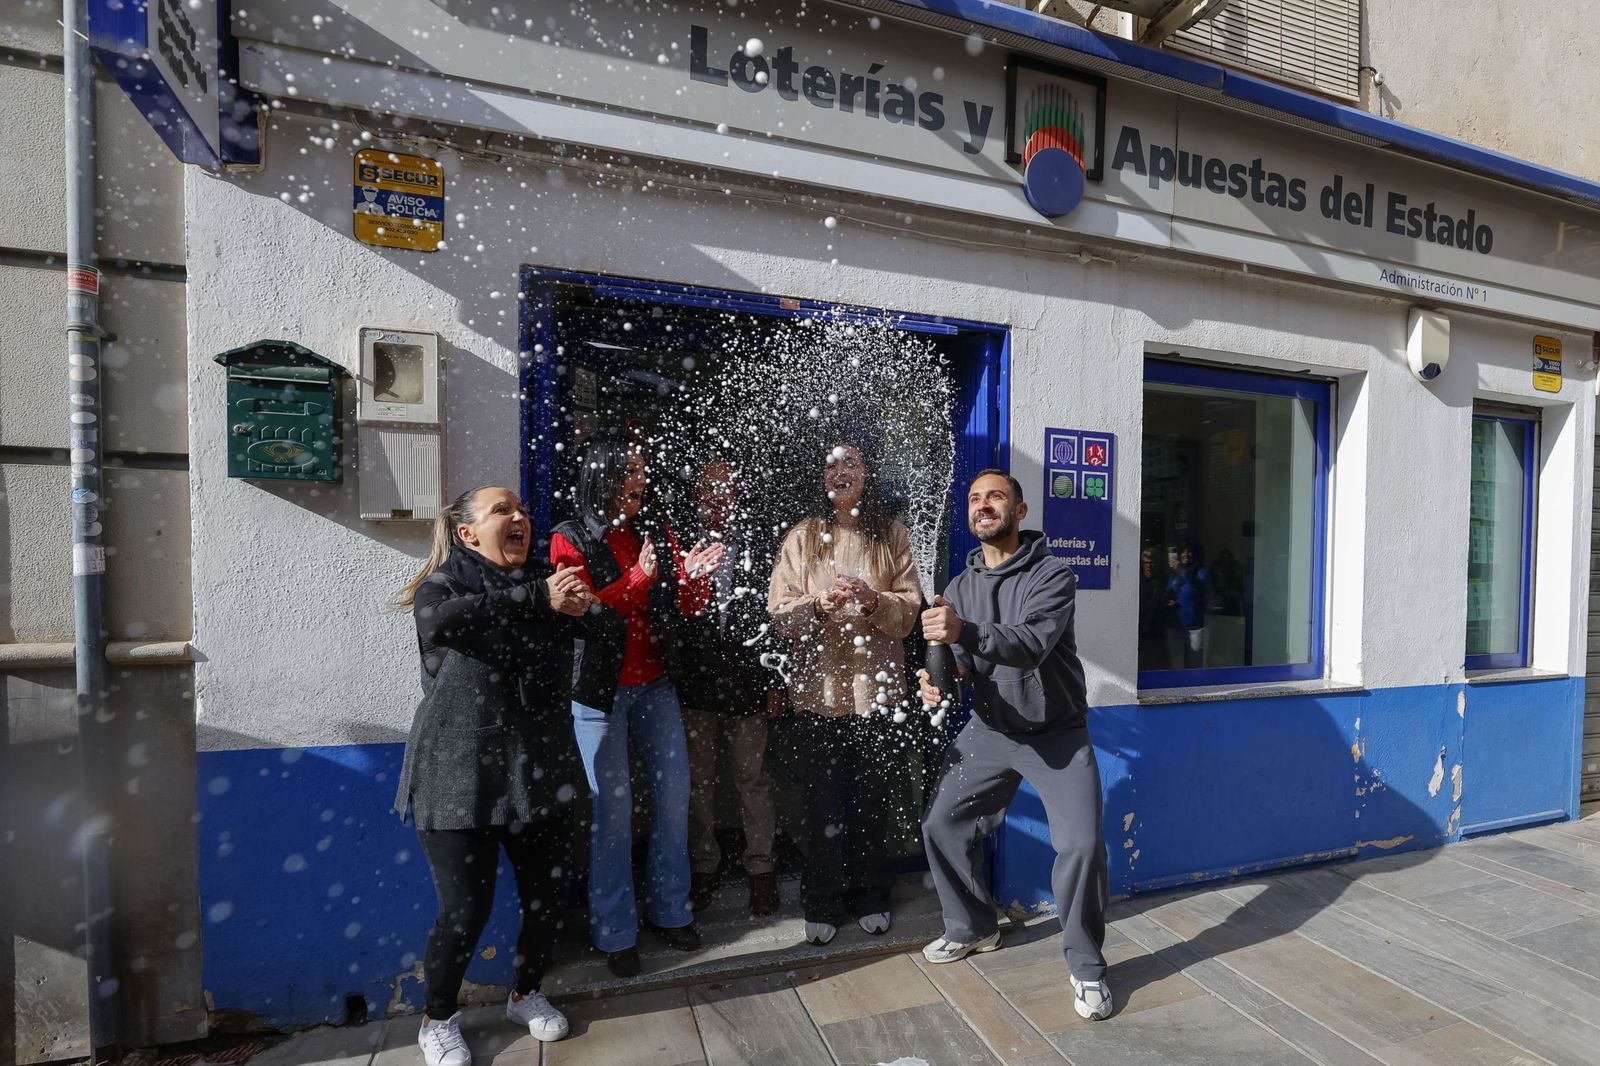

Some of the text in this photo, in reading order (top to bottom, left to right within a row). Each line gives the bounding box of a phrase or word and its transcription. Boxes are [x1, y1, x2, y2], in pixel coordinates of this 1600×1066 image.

[690, 25, 1494, 254] Loterías y Apuestas del Estado
[381, 169, 438, 186] SECUR
[387, 194, 426, 206] AVISO
[1379, 269, 1463, 298] Administración
[1482, 289, 1487, 302] 1
[1046, 537, 1096, 551] Loterías y
[1056, 555, 1109, 566] uestas del
